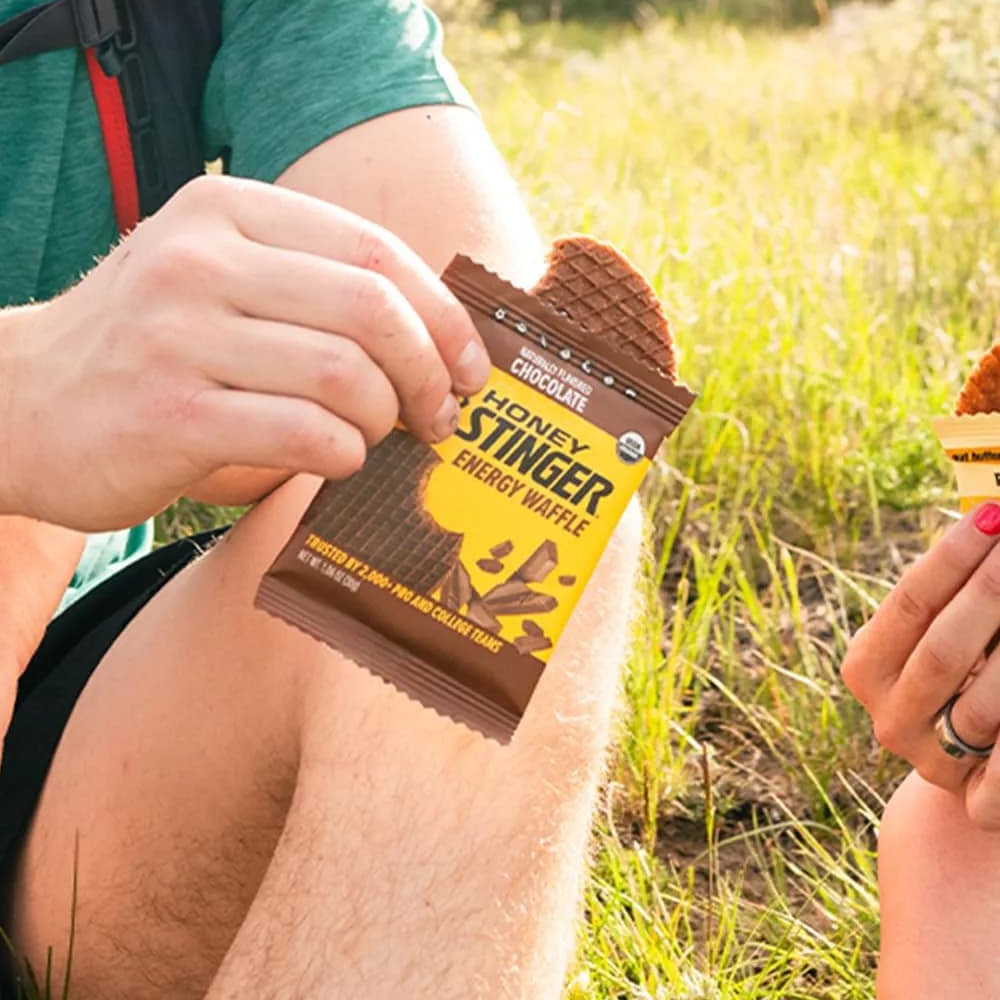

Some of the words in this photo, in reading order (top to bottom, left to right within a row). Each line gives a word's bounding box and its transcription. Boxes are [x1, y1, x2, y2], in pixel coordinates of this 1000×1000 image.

[482, 389, 591, 455] HONEY
[510, 357, 590, 413] CHOCOLATE
[451, 448, 526, 498] ENERGY
[520, 487, 591, 538] WAFFLE
[454, 405, 615, 516] STINGER
[304, 533, 348, 565] TRUSTED
[344, 556, 364, 572] BY
[391, 583, 415, 602] PRO
[410, 595, 434, 614] AND
[431, 606, 474, 636] COLLEGE
[469, 627, 504, 654] TEAMS
